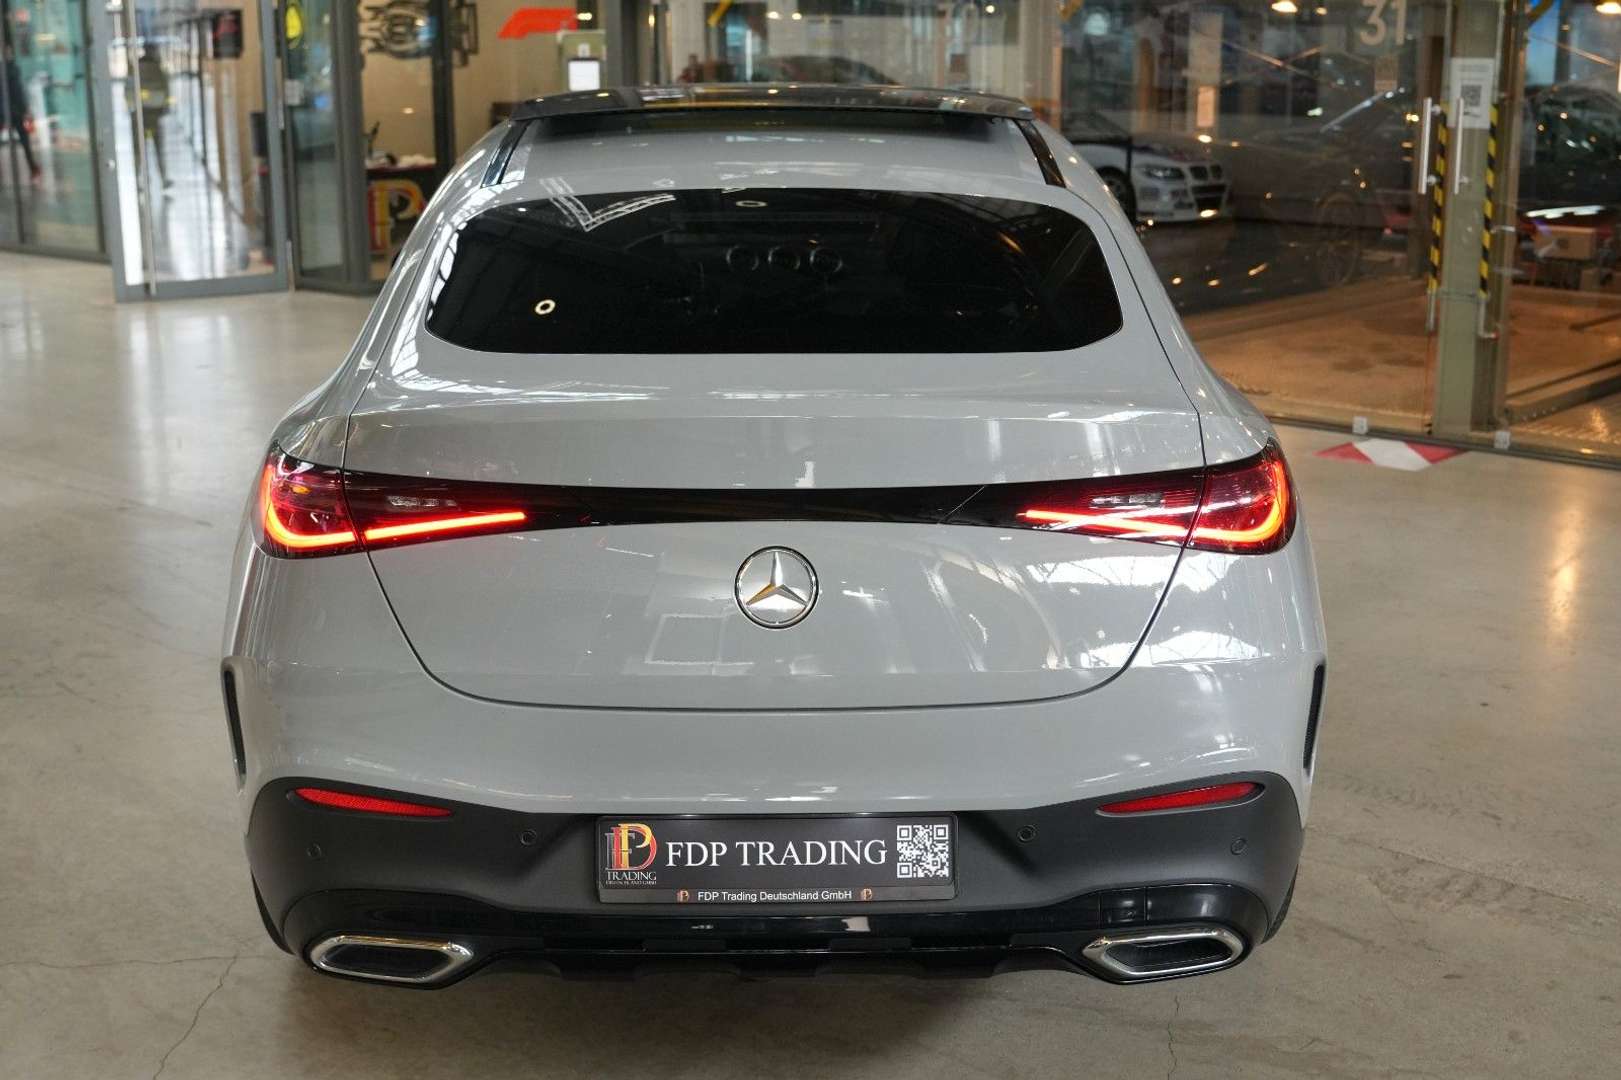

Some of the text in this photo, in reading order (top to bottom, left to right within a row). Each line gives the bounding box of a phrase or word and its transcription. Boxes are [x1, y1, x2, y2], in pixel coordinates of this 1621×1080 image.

[1359, 0, 1407, 45] 31
[665, 839, 888, 867] FDP TRADING
[607, 871, 657, 881] TRADING
[697, 890, 852, 903] FDP Trading Deutschland GmbH
